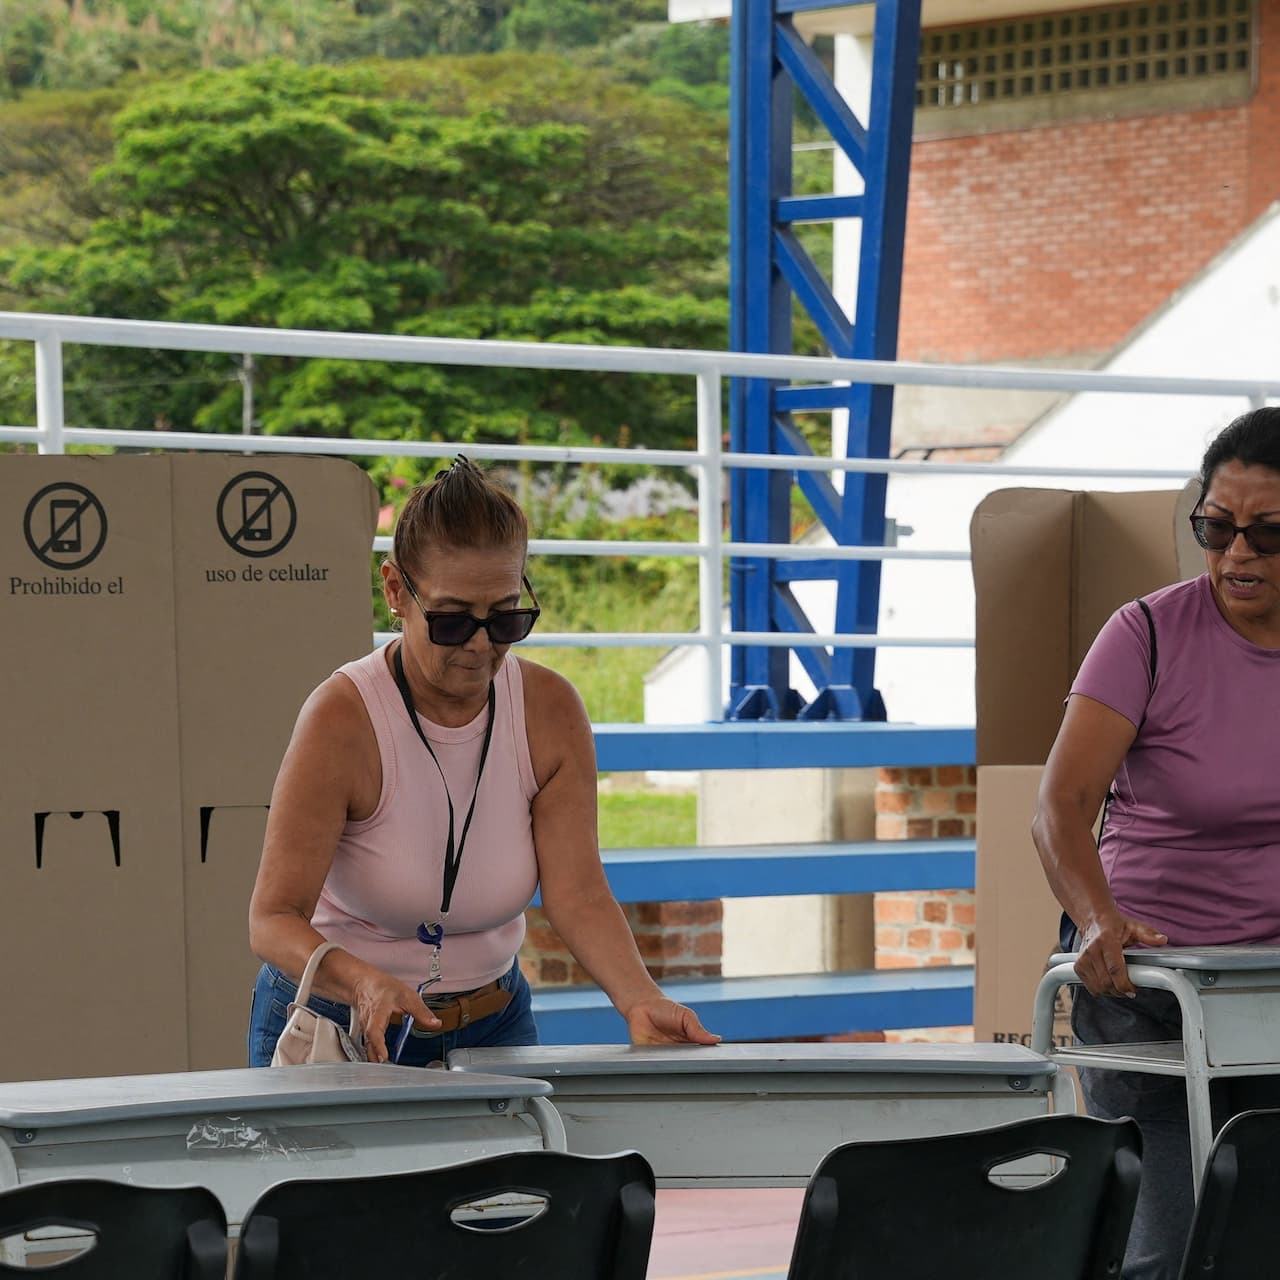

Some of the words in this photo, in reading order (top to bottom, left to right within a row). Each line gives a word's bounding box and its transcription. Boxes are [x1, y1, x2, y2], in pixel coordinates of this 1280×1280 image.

[206, 569, 236, 582] uso
[242, 565, 264, 581] de
[268, 564, 329, 581] celular
[9, 576, 102, 595] Prohibido
[107, 576, 124, 594] el
